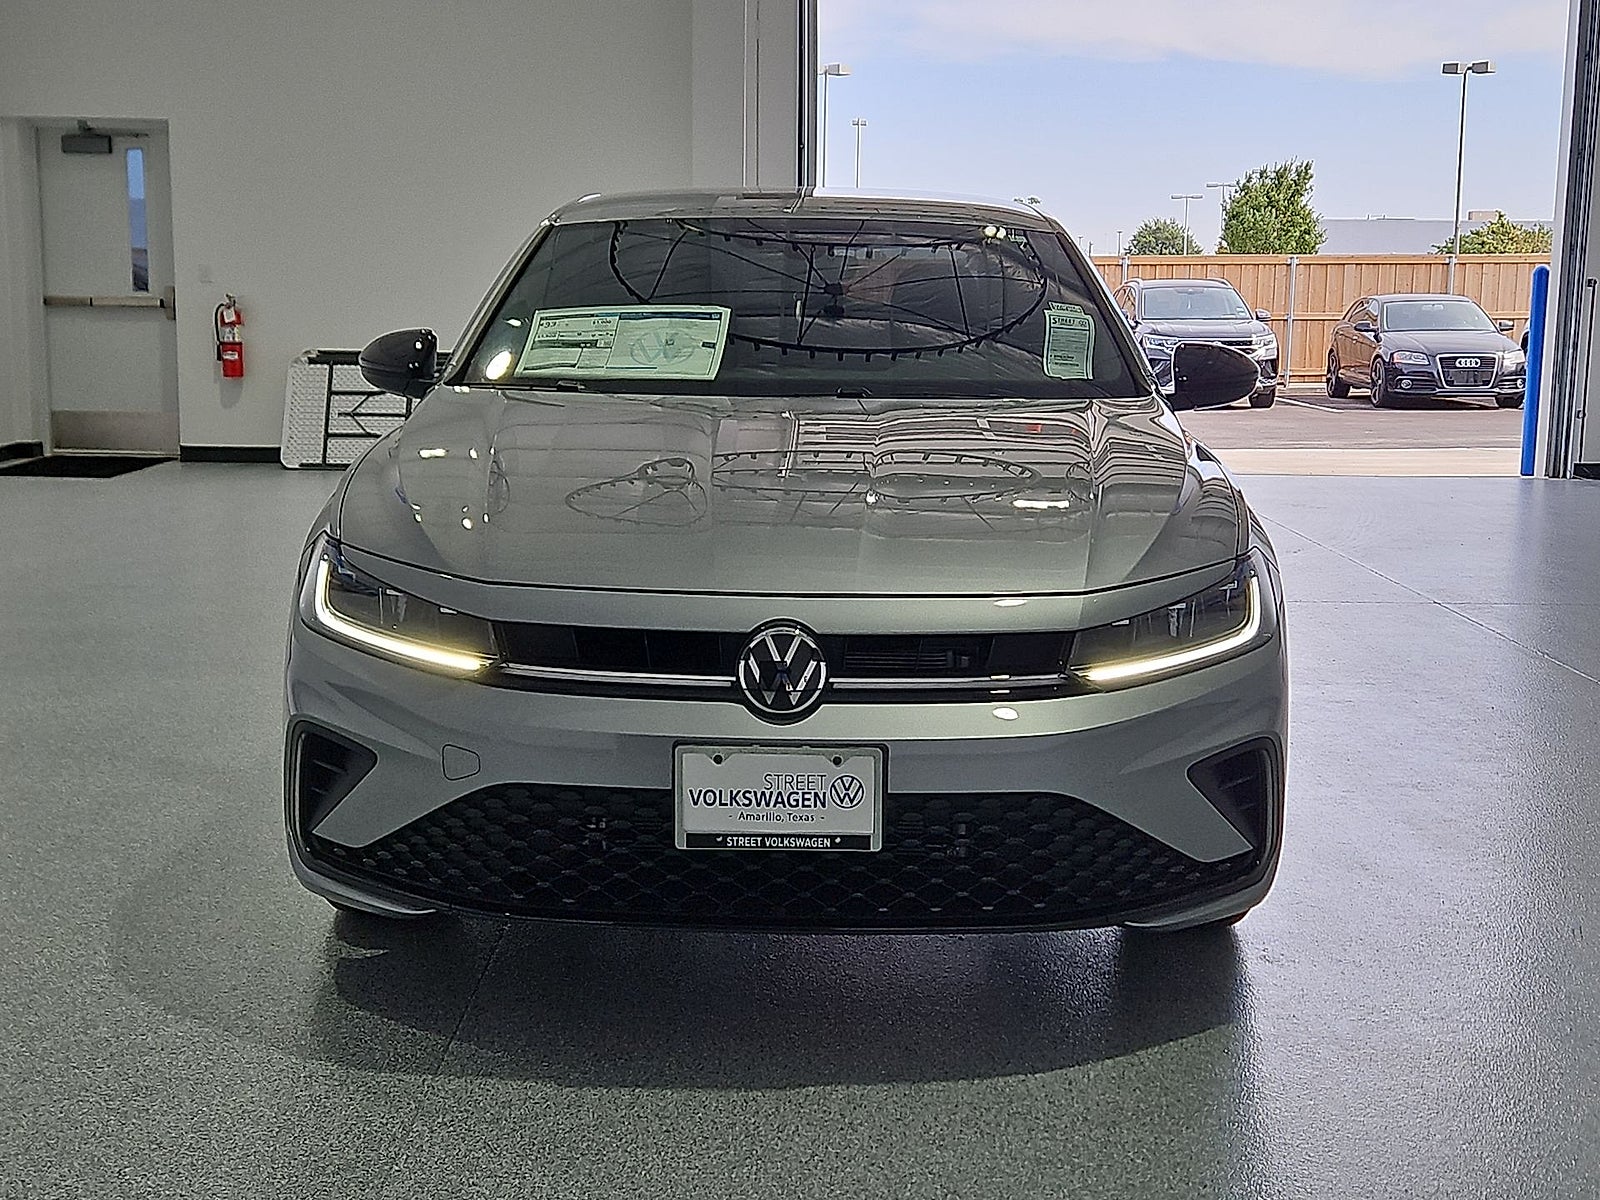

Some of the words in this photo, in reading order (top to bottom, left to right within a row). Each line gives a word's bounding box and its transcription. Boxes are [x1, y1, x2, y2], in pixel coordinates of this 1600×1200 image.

[763, 773, 827, 791] STREET
[688, 788, 827, 809] VOLKSWAGEN
[738, 811, 785, 823] Amarillo,
[787, 812, 815, 822] Texas
[726, 837, 763, 848] STREET
[764, 837, 831, 848] VOLKSWAGEN
